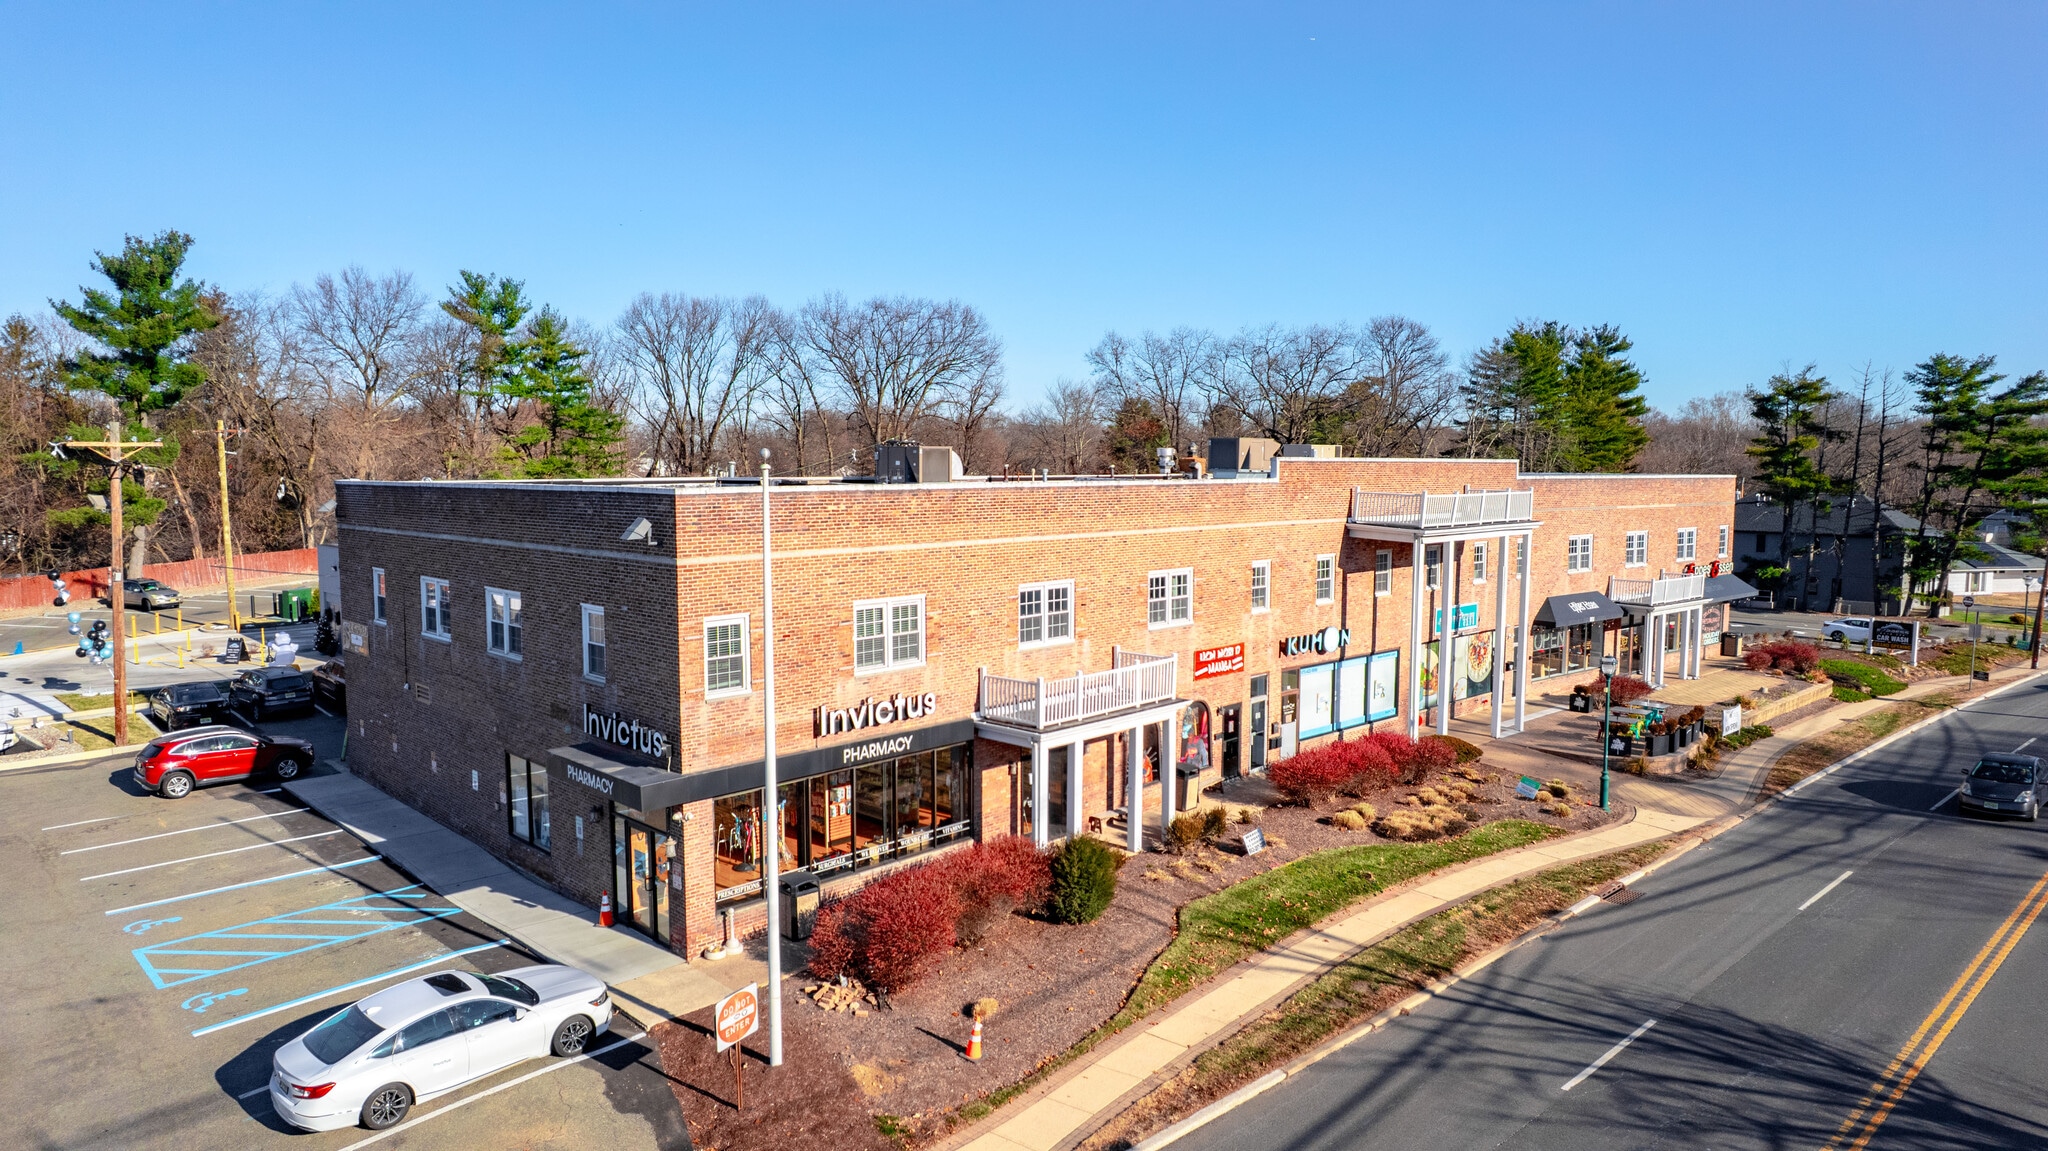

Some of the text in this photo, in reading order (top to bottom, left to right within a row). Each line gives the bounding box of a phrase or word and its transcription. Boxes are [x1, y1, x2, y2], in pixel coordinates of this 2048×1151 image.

[1287, 626, 1350, 655] KUMON
[1534, 630, 1565, 650] OPEN
[820, 692, 936, 736] Invictus
[583, 703, 663, 757] Invictus
[843, 734, 913, 763] PHARMACY
[567, 765, 614, 795] PHARMACY
[942, 824, 963, 834] VITAMINS
[818, 857, 846, 870] SURGICALS
[717, 881, 761, 900] PRESCRIPTIONS
[724, 996, 750, 1018] DO NOT
[726, 1018, 750, 1038] ENTER
